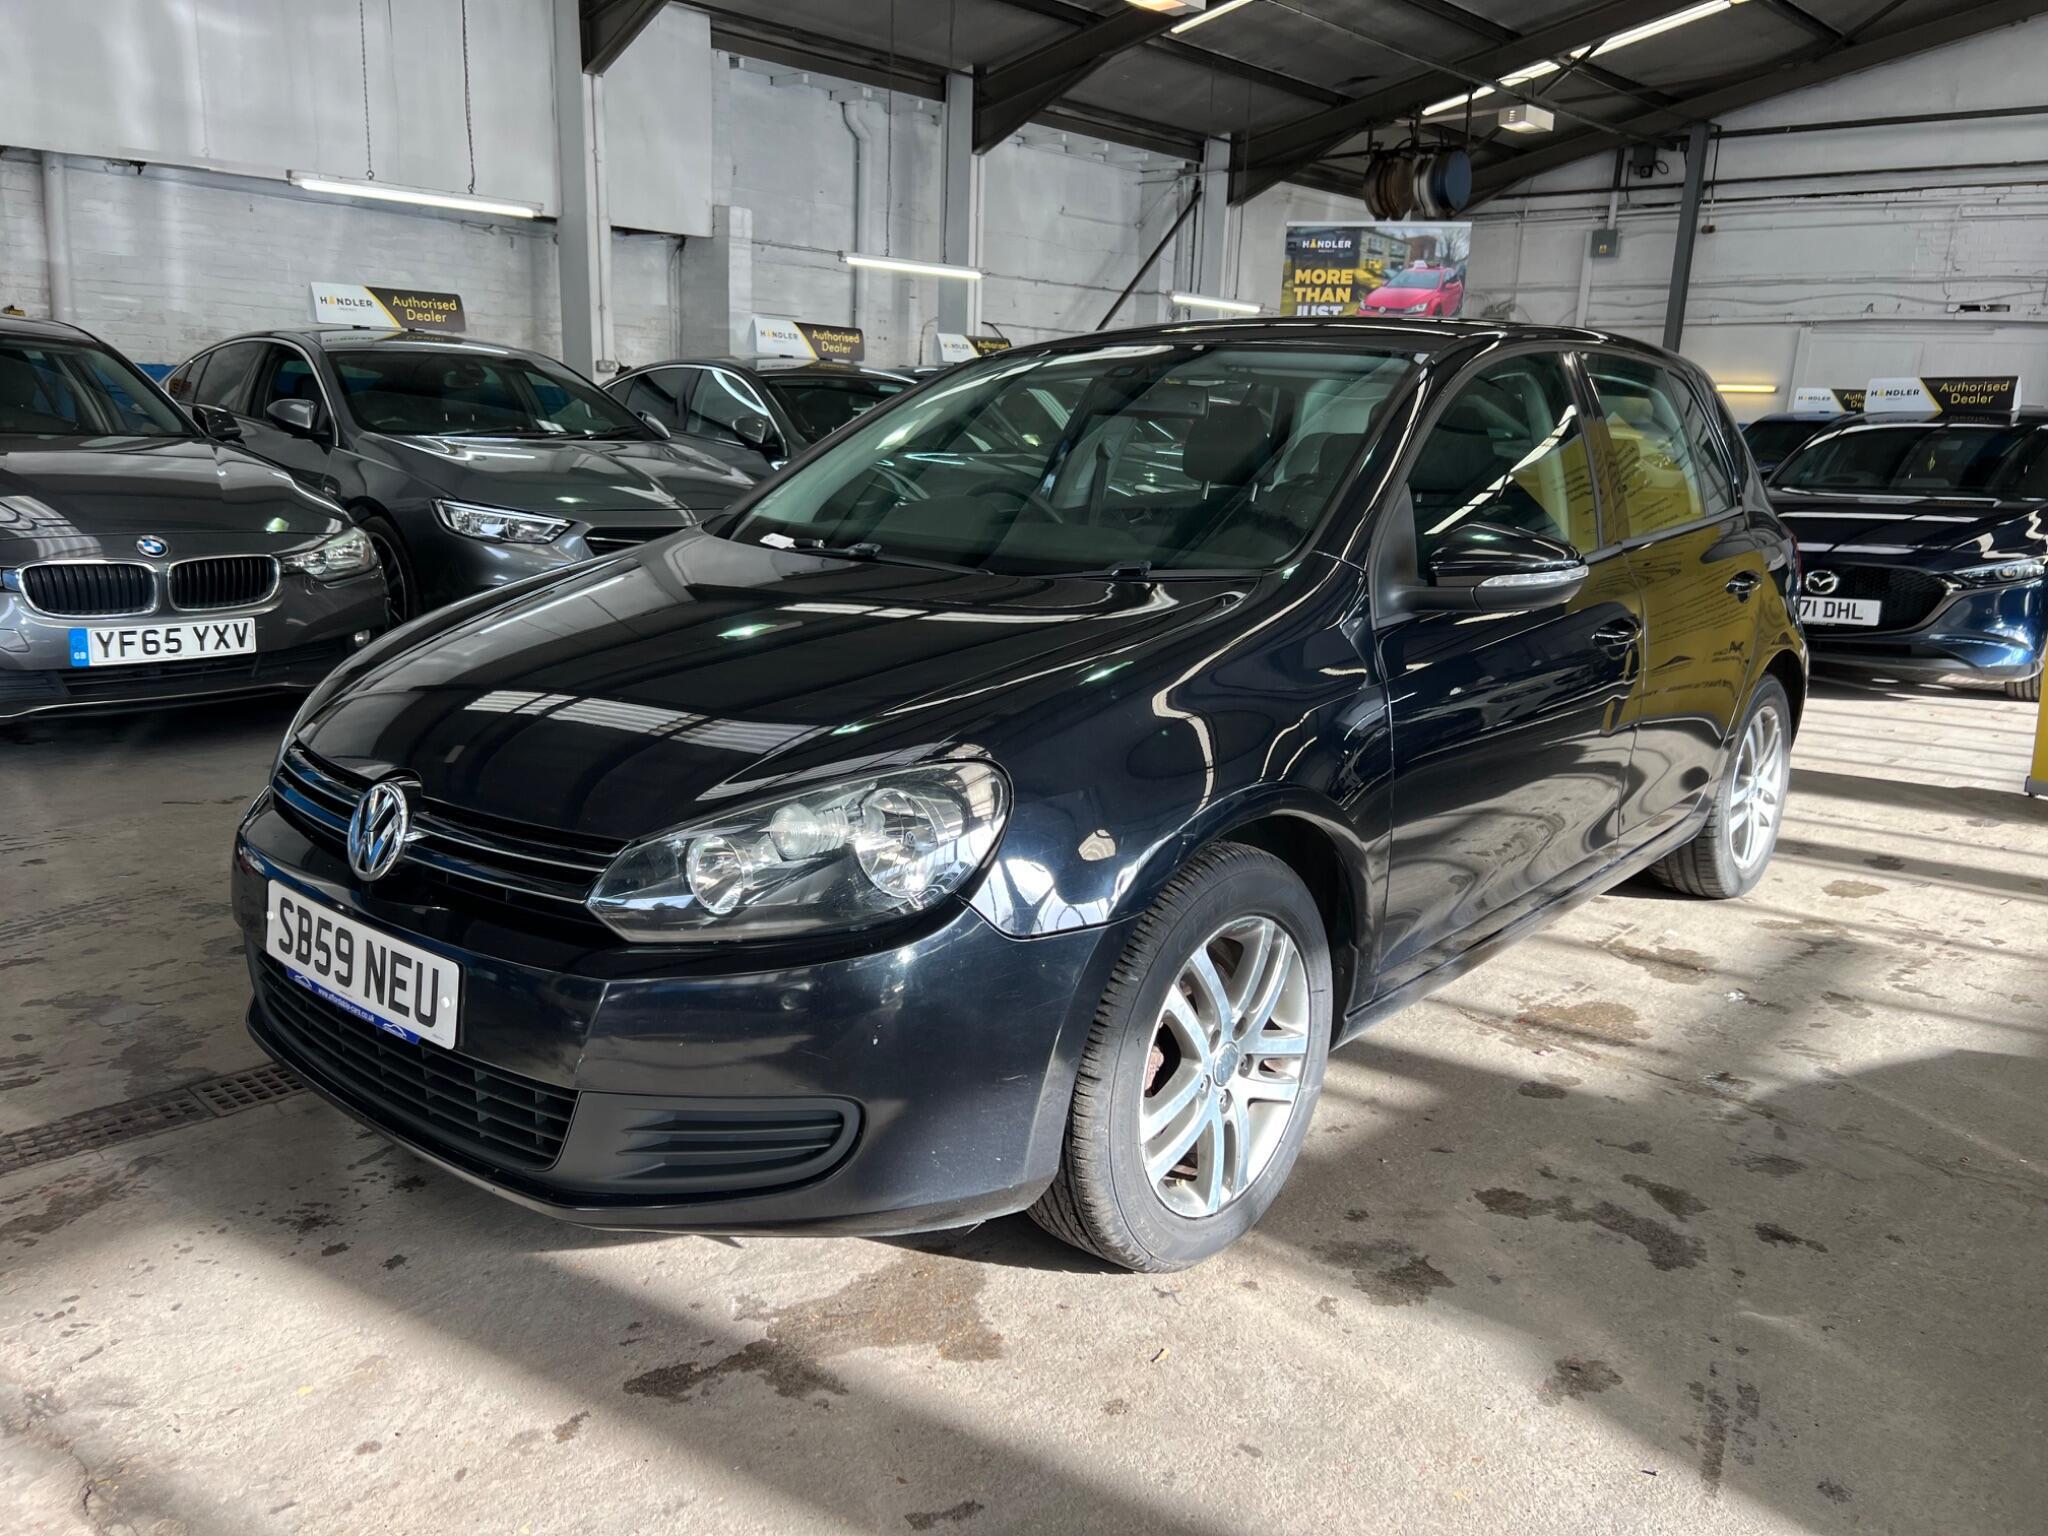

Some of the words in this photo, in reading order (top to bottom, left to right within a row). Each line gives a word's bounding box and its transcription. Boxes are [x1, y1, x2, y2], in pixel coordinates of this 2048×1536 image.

[1294, 268, 1354, 285] MORE
[1293, 286, 1352, 303] THAN
[392, 295, 457, 311] Authorised
[406, 309, 447, 323] Dealer
[812, 329, 860, 344] Authorised
[821, 340, 852, 354] Dealer
[1939, 381, 2010, 393] Authorised
[1950, 393, 1995, 405] Dealer
[1823, 601, 1864, 620] DHL
[95, 627, 183, 659] YF65
[192, 622, 249, 652] YXV
[278, 896, 355, 989] SB59
[363, 939, 440, 1029] NEU
